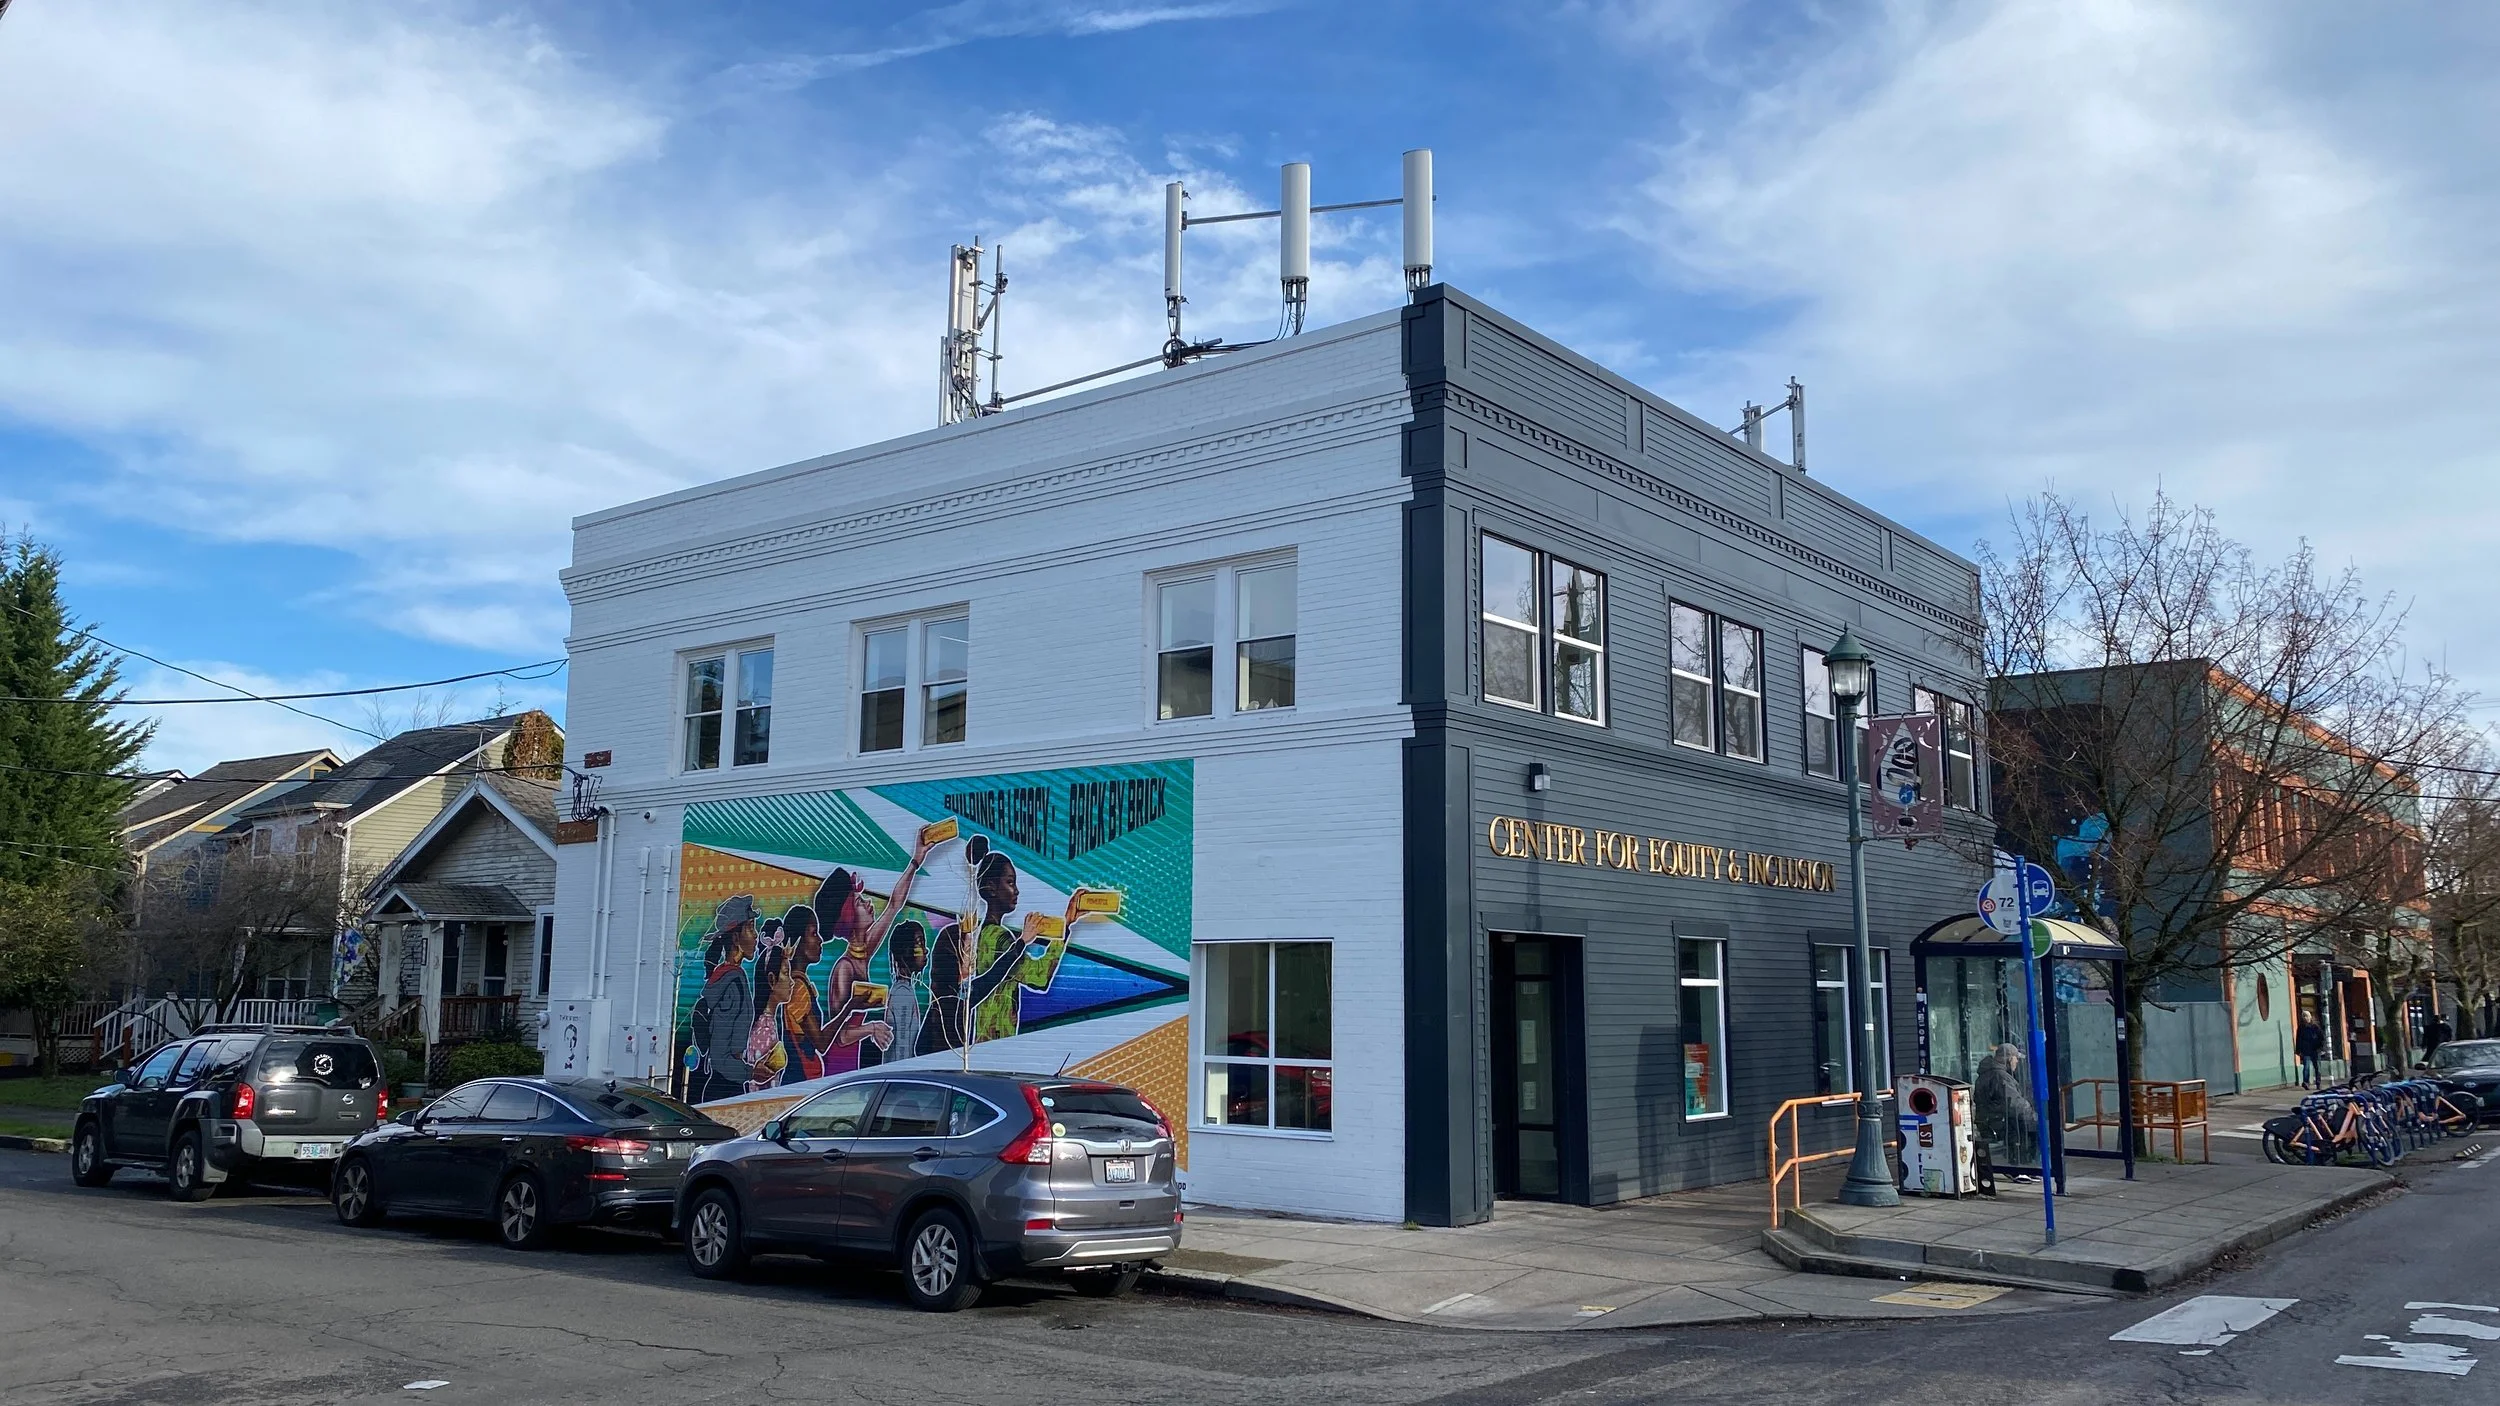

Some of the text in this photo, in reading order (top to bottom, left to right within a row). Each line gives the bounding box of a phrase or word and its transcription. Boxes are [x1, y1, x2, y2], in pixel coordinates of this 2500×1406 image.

[944, 790, 995, 831] BUILDING
[997, 789, 1006, 836] A
[1068, 780, 1107, 861] BRICK
[1108, 780, 1126, 842] BY
[1128, 776, 1167, 833] BRICK
[1488, 815, 1836, 893] CENTER FOR EQUITY & INCLUSION
[1998, 897, 2015, 908] 72
